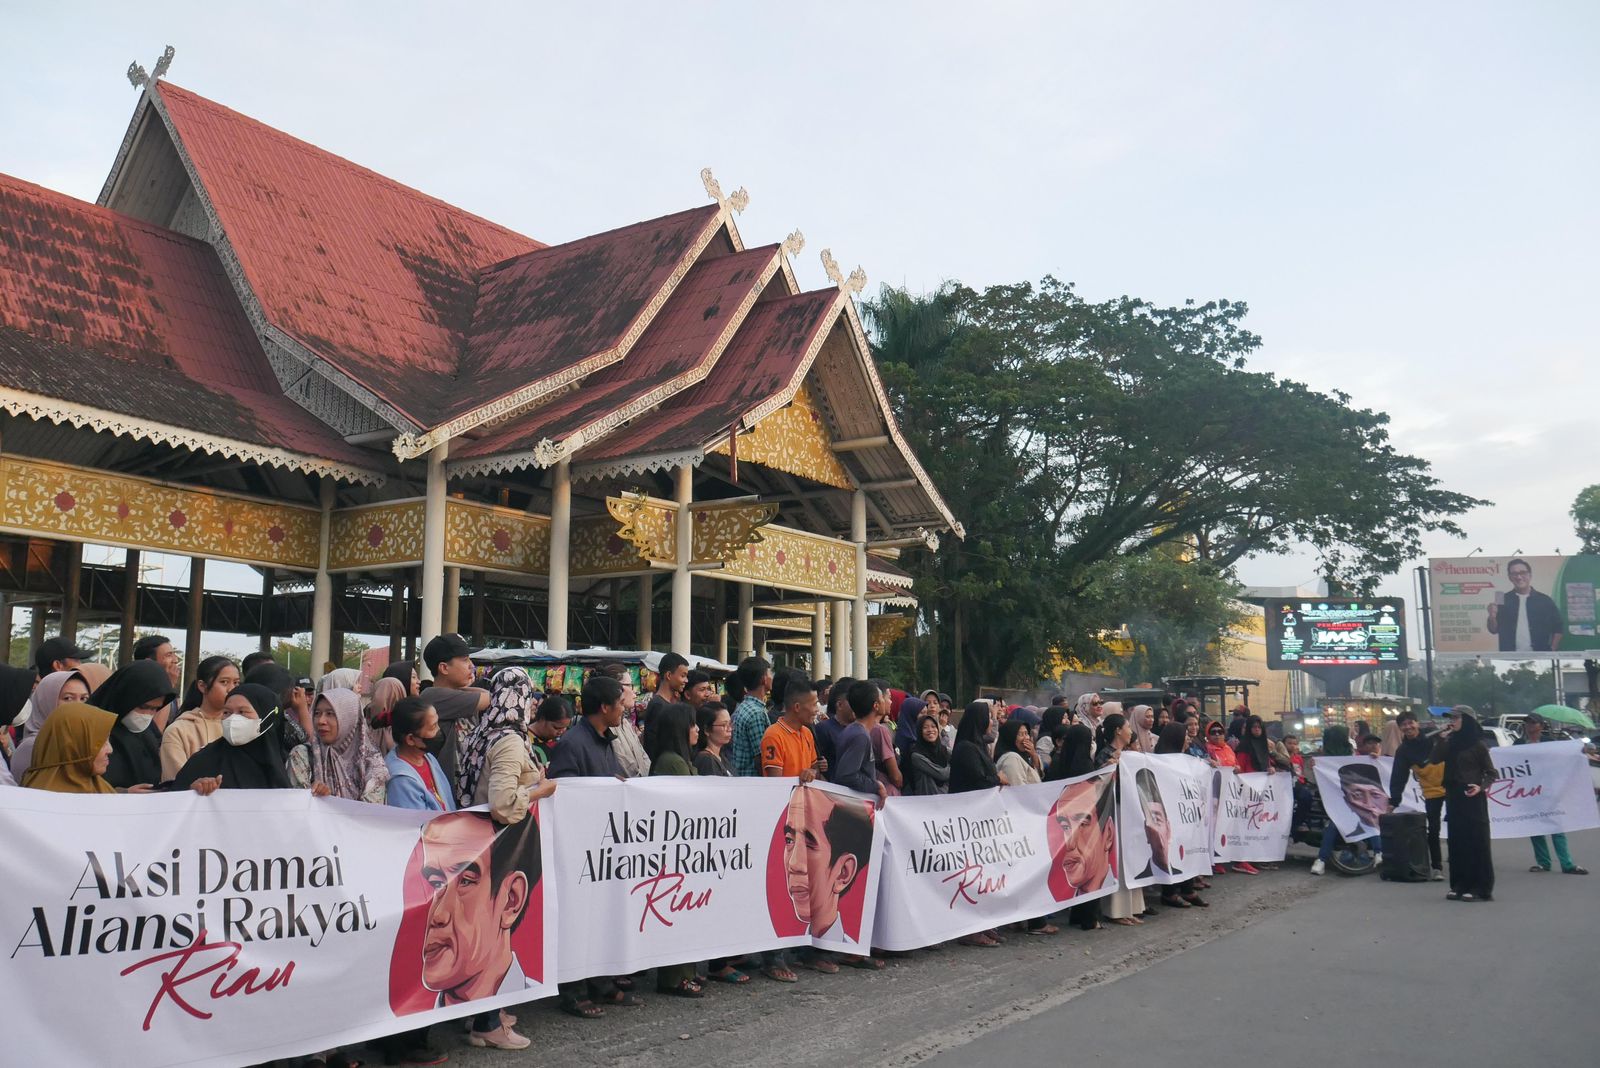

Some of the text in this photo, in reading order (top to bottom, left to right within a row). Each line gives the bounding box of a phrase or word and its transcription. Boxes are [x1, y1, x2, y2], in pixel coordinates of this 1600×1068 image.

[766, 745, 776, 760] 3
[601, 808, 737, 845] Aksi Damai
[924, 811, 1013, 847] Aksi Damai
[70, 845, 343, 900] Aksi Damai
[579, 842, 752, 884] Aliansi Rakyat
[906, 836, 1035, 876] Aliansi Rakyat
[631, 864, 712, 932] Riau
[942, 856, 1006, 909] Riau
[11, 894, 376, 958] Aliansi Rakyat
[120, 930, 295, 1031] Riau
